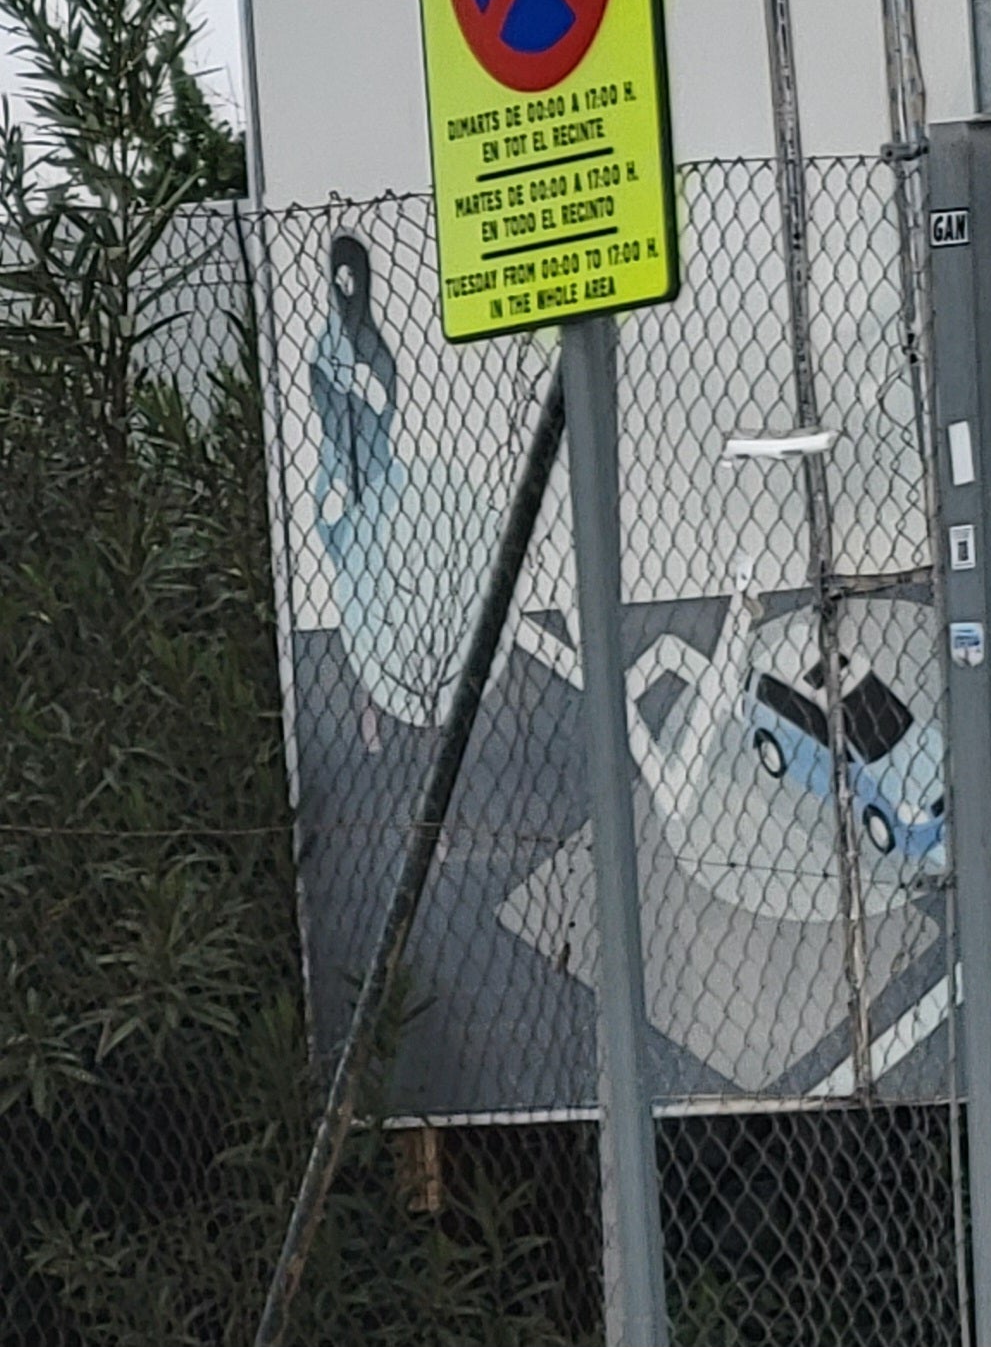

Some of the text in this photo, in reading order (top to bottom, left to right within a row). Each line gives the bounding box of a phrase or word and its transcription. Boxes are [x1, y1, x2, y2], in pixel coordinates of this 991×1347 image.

[447, 110, 500, 141] DIMARTS
[505, 105, 522, 128] DE
[527, 95, 565, 123] 00:00
[572, 92, 579, 113] A
[585, 84, 618, 111] 17:00
[482, 117, 605, 163] EN TOT EL RECINTE
[455, 189, 503, 218] MARTES
[507, 184, 524, 207] DE
[530, 175, 567, 202] 00:00
[574, 172, 582, 193] A
[587, 164, 620, 191] 17:00
[482, 195, 615, 242] EN TODO EL RECINTO
[933, 214, 966, 242] GAN
[445, 270, 498, 299] TUESDAY
[503, 262, 536, 287] FROM
[542, 252, 580, 279] 00:00
[585, 248, 602, 271] TO
[607, 240, 641, 266] 17:00
[490, 276, 616, 319] IN THE WHOLE AREA
